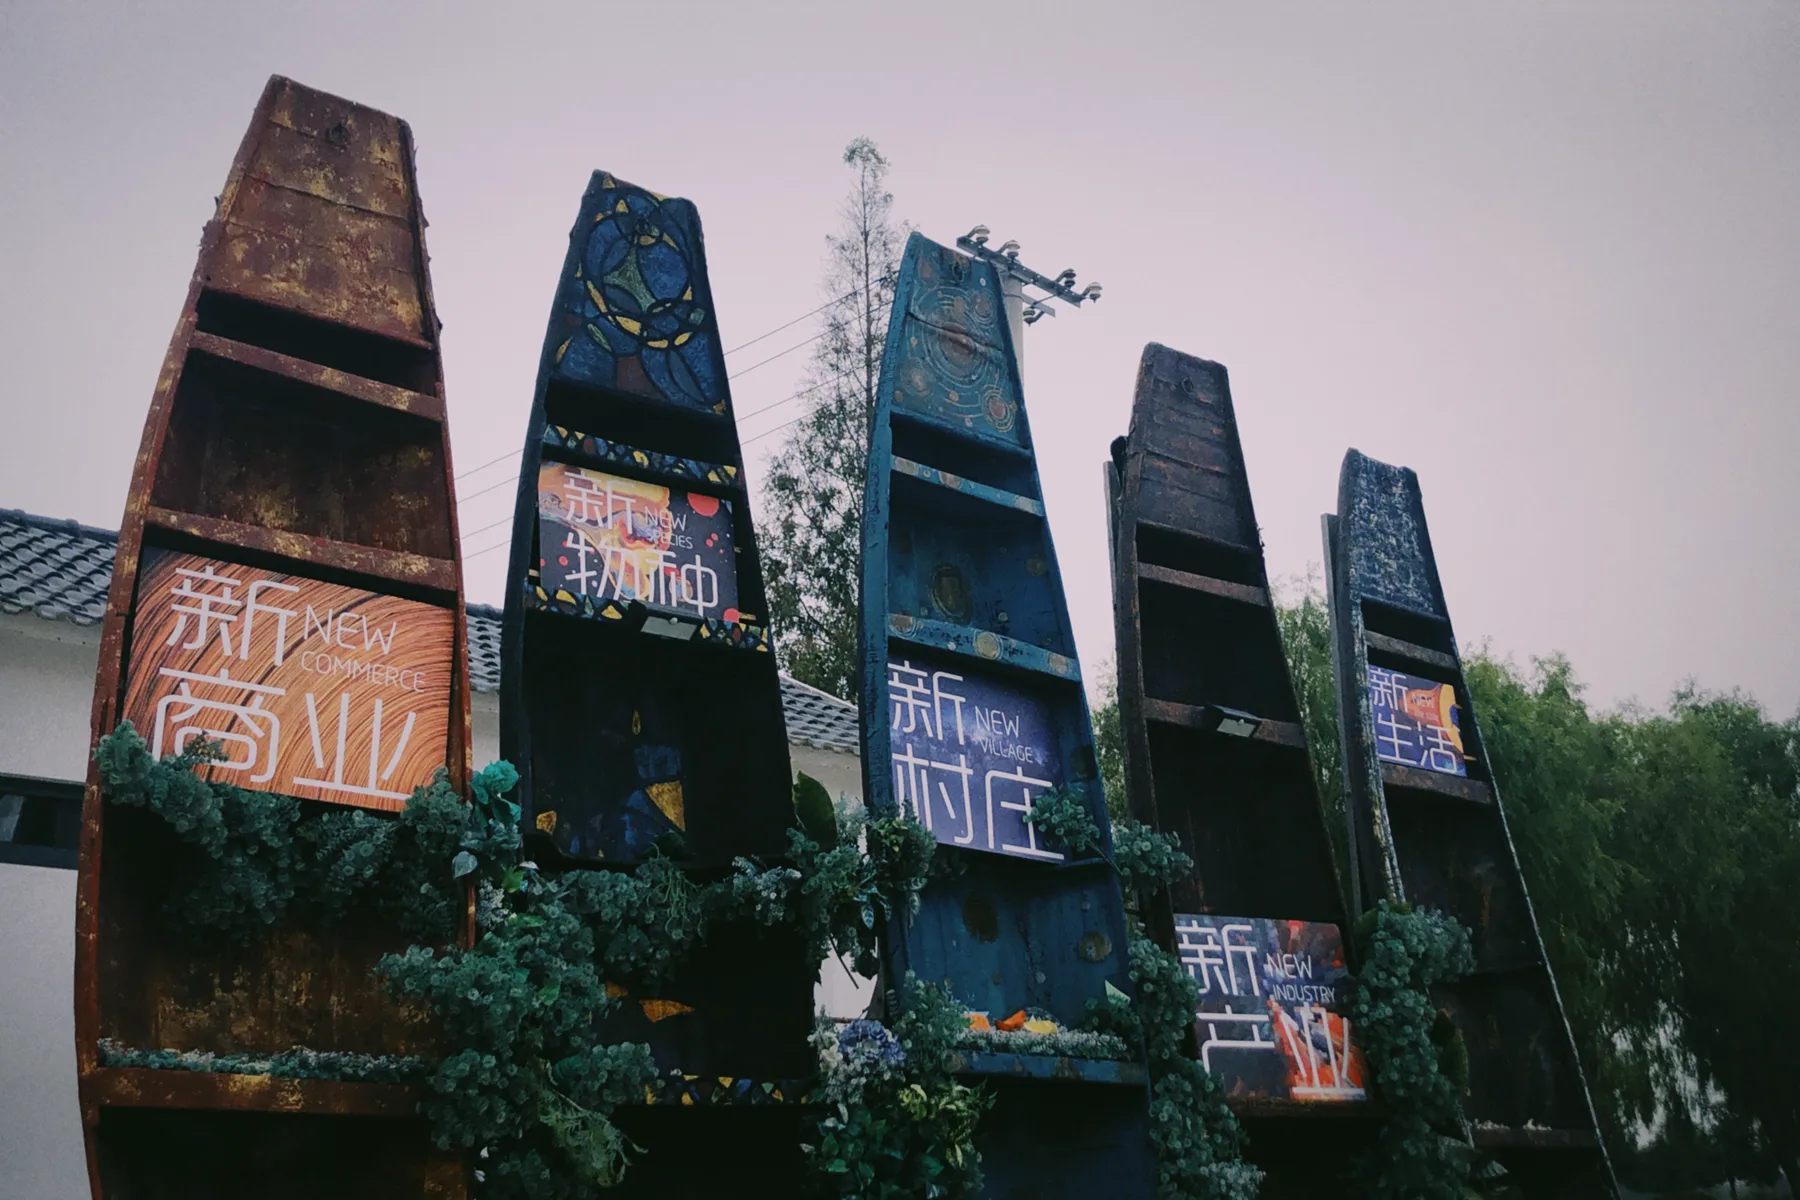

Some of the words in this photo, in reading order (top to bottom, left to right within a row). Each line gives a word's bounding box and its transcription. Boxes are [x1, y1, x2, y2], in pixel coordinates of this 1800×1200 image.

[563, 468, 637, 534] 新
[644, 506, 687, 532] NEW
[646, 528, 694, 550] SPECIES
[565, 531, 719, 617] 物种
[165, 565, 300, 666] 新
[303, 604, 397, 655] NEW
[301, 650, 427, 693] COMMERCE
[1370, 668, 1409, 713] 新
[887, 660, 967, 745] 新
[974, 705, 1020, 738] NEW
[153, 667, 416, 801] 商业
[980, 738, 1034, 764] VILLAGE
[1377, 712, 1460, 773] 生活
[892, 743, 1064, 860] 村庄
[1175, 919, 1260, 997] 新
[1265, 952, 1313, 979] NEW
[1273, 984, 1335, 1004] INDUSTRY
[1196, 1001, 1366, 1096] 产业
